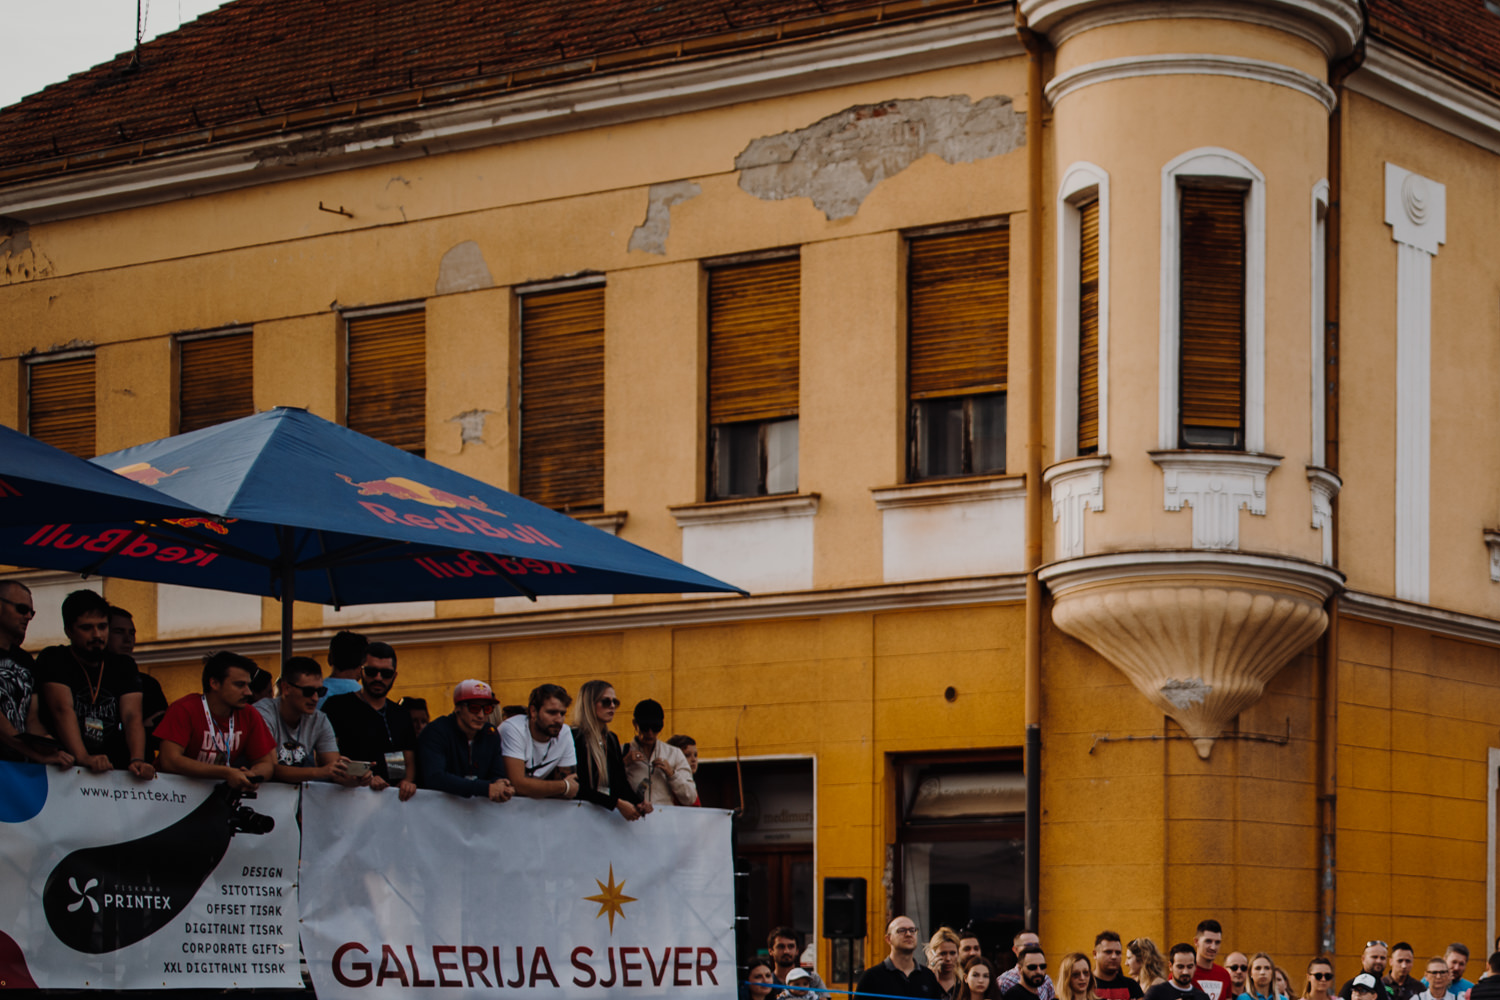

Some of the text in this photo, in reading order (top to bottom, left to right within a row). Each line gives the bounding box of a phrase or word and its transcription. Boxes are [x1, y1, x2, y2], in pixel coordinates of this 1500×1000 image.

[80, 786, 187, 804] www.printex.hr
[241, 866, 284, 878] DESIGN
[221, 884, 283, 897] SITOTISAK
[103, 892, 172, 911] PRINTEX
[206, 903, 282, 917] OFFSET TISAK
[185, 922, 283, 935] DIGITALNI TISAK
[181, 942, 285, 955] CORPORATE GIFTS
[163, 961, 286, 974] XXL DIGITALNI TISAK
[331, 941, 719, 989] GALERIJA SJEVER
